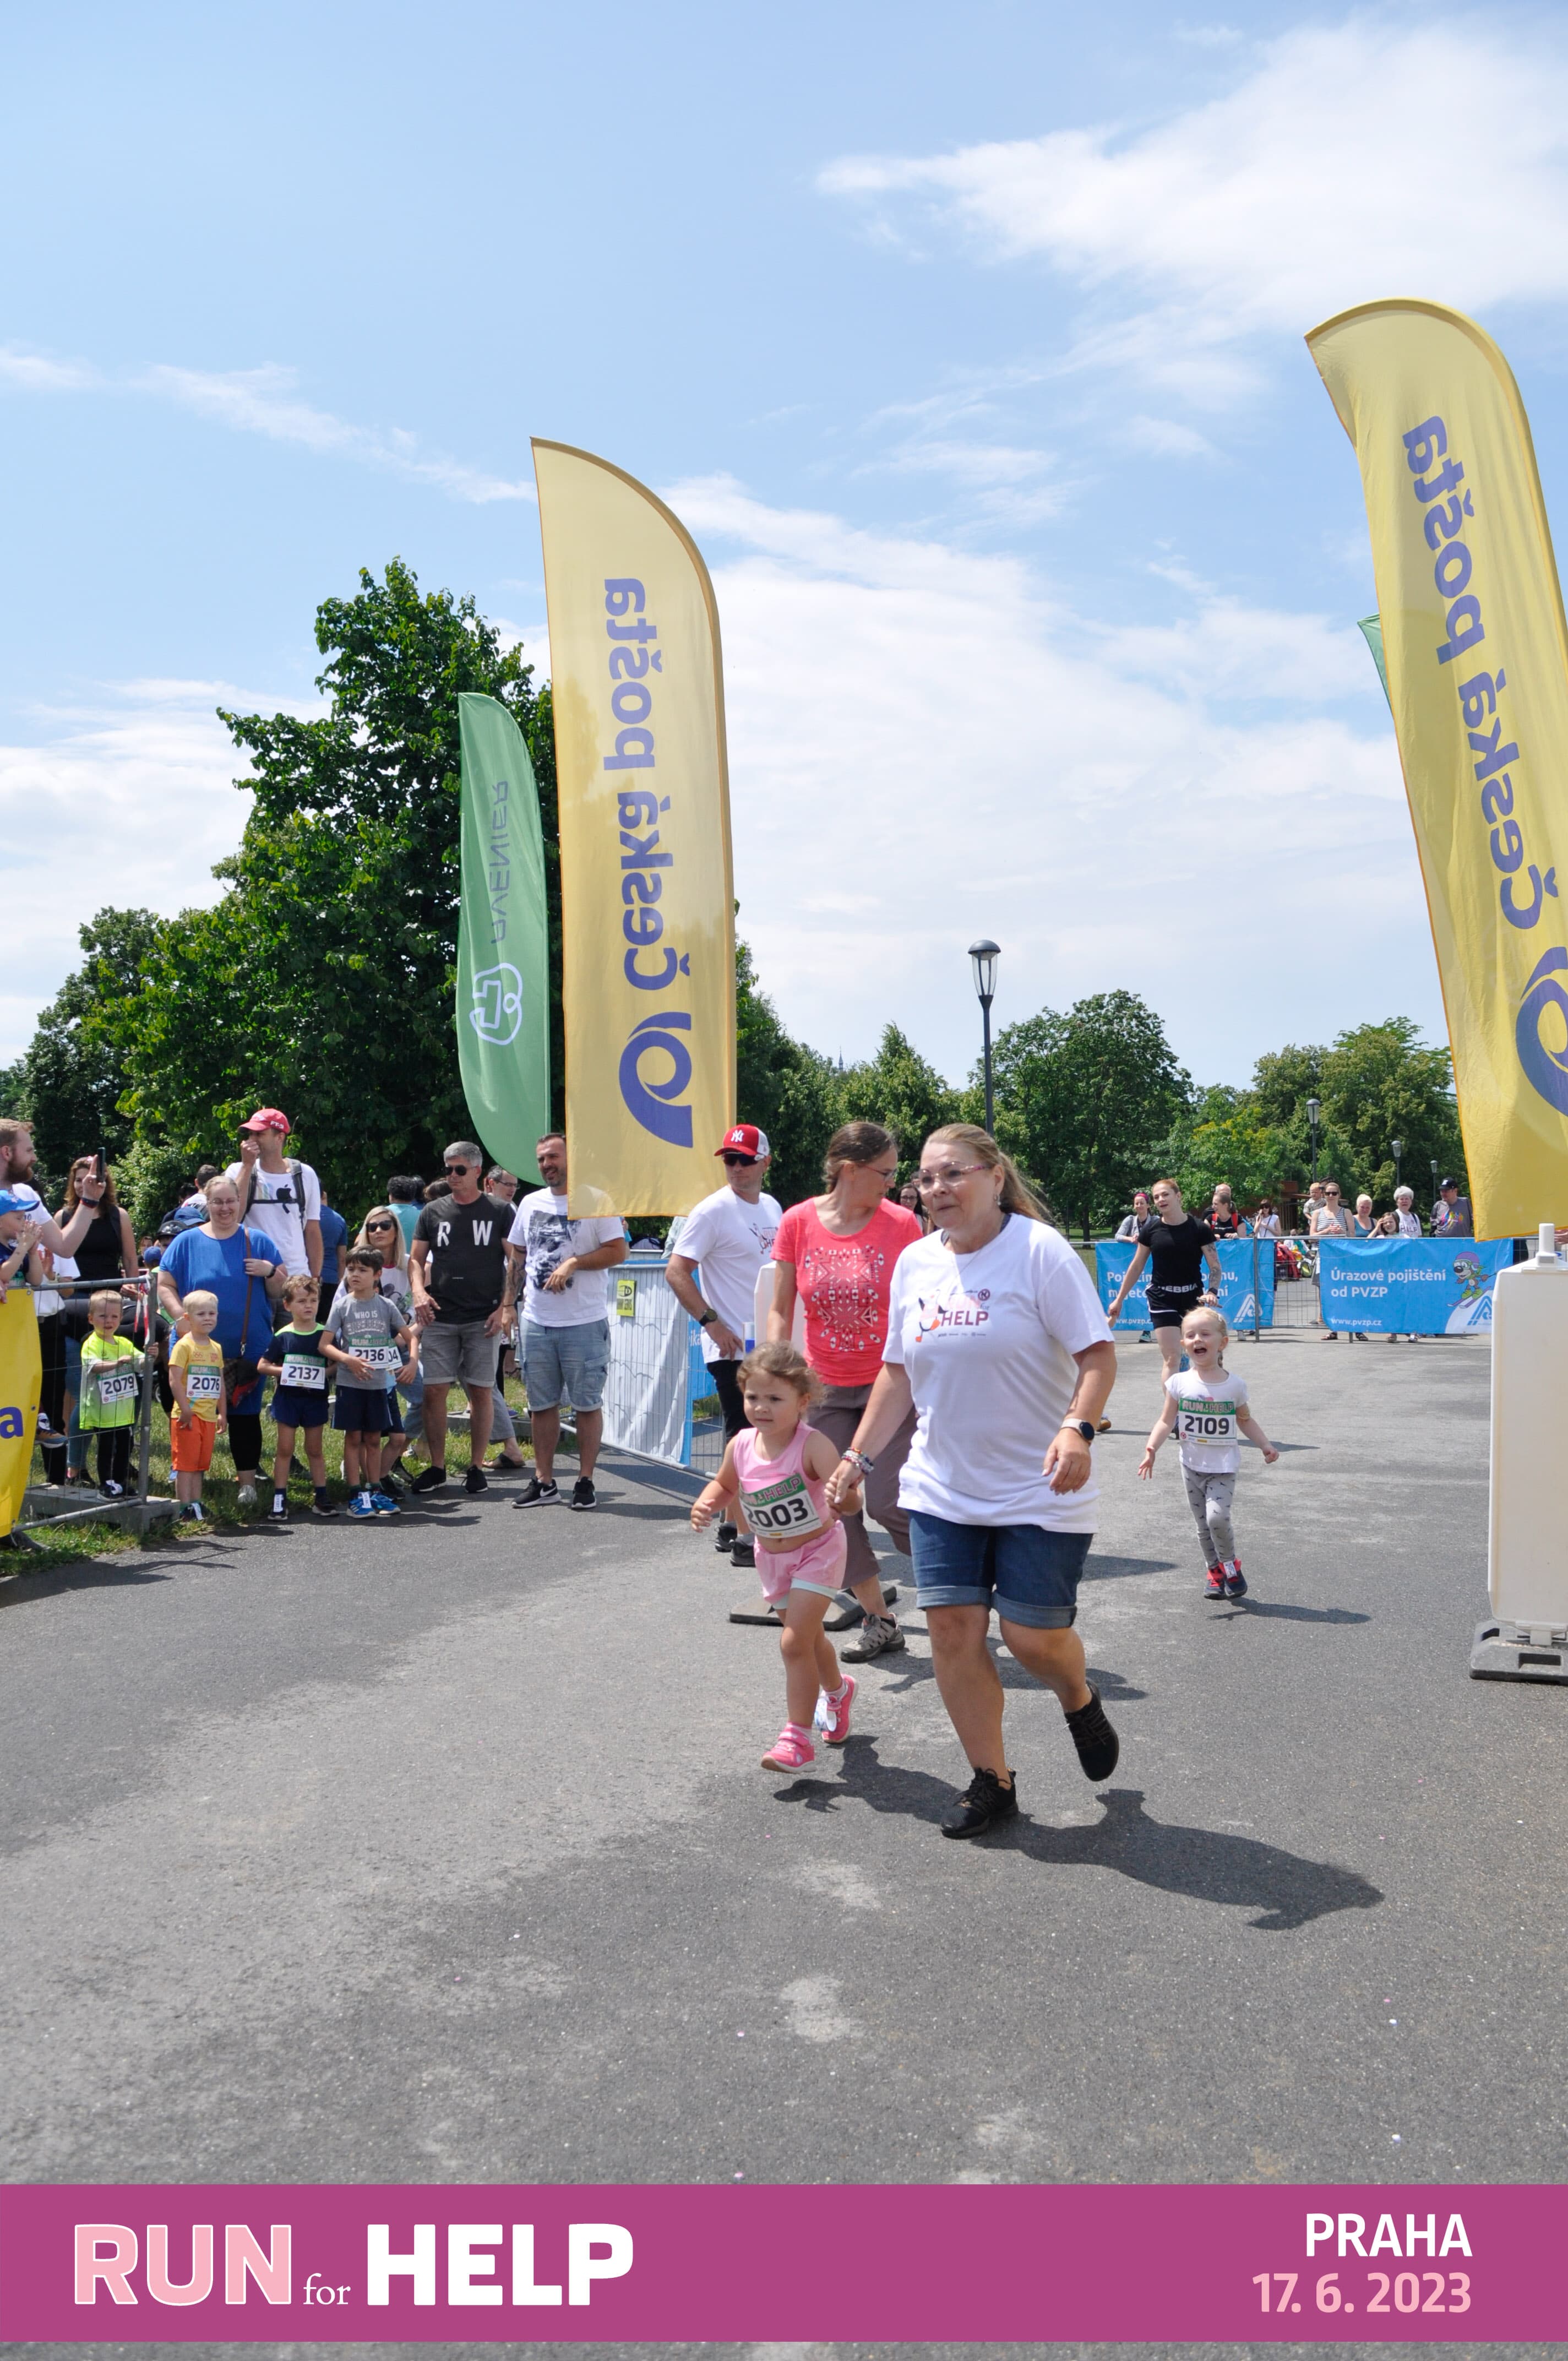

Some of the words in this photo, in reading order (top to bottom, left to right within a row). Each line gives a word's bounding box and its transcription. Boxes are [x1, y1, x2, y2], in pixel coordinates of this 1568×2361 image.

[472, 1220, 493, 1246] W
[1331, 1267, 1384, 1281] Úrazové
[1388, 1269, 1446, 1283] pojištění
[1331, 1286, 1347, 1297] od
[1352, 1286, 1388, 1297] PVZP
[940, 1310, 989, 1326] HELP
[1331, 1318, 1382, 1326] www.pvzp.cz
[355, 1348, 384, 1362] 2136
[288, 1366, 320, 1380] 2137
[104, 1375, 134, 1395] 2079
[192, 1377, 220, 1391] 2076
[1185, 1415, 1229, 1435] 2109
[764, 1478, 800, 1500] HELP
[743, 1498, 808, 1528] 2003
